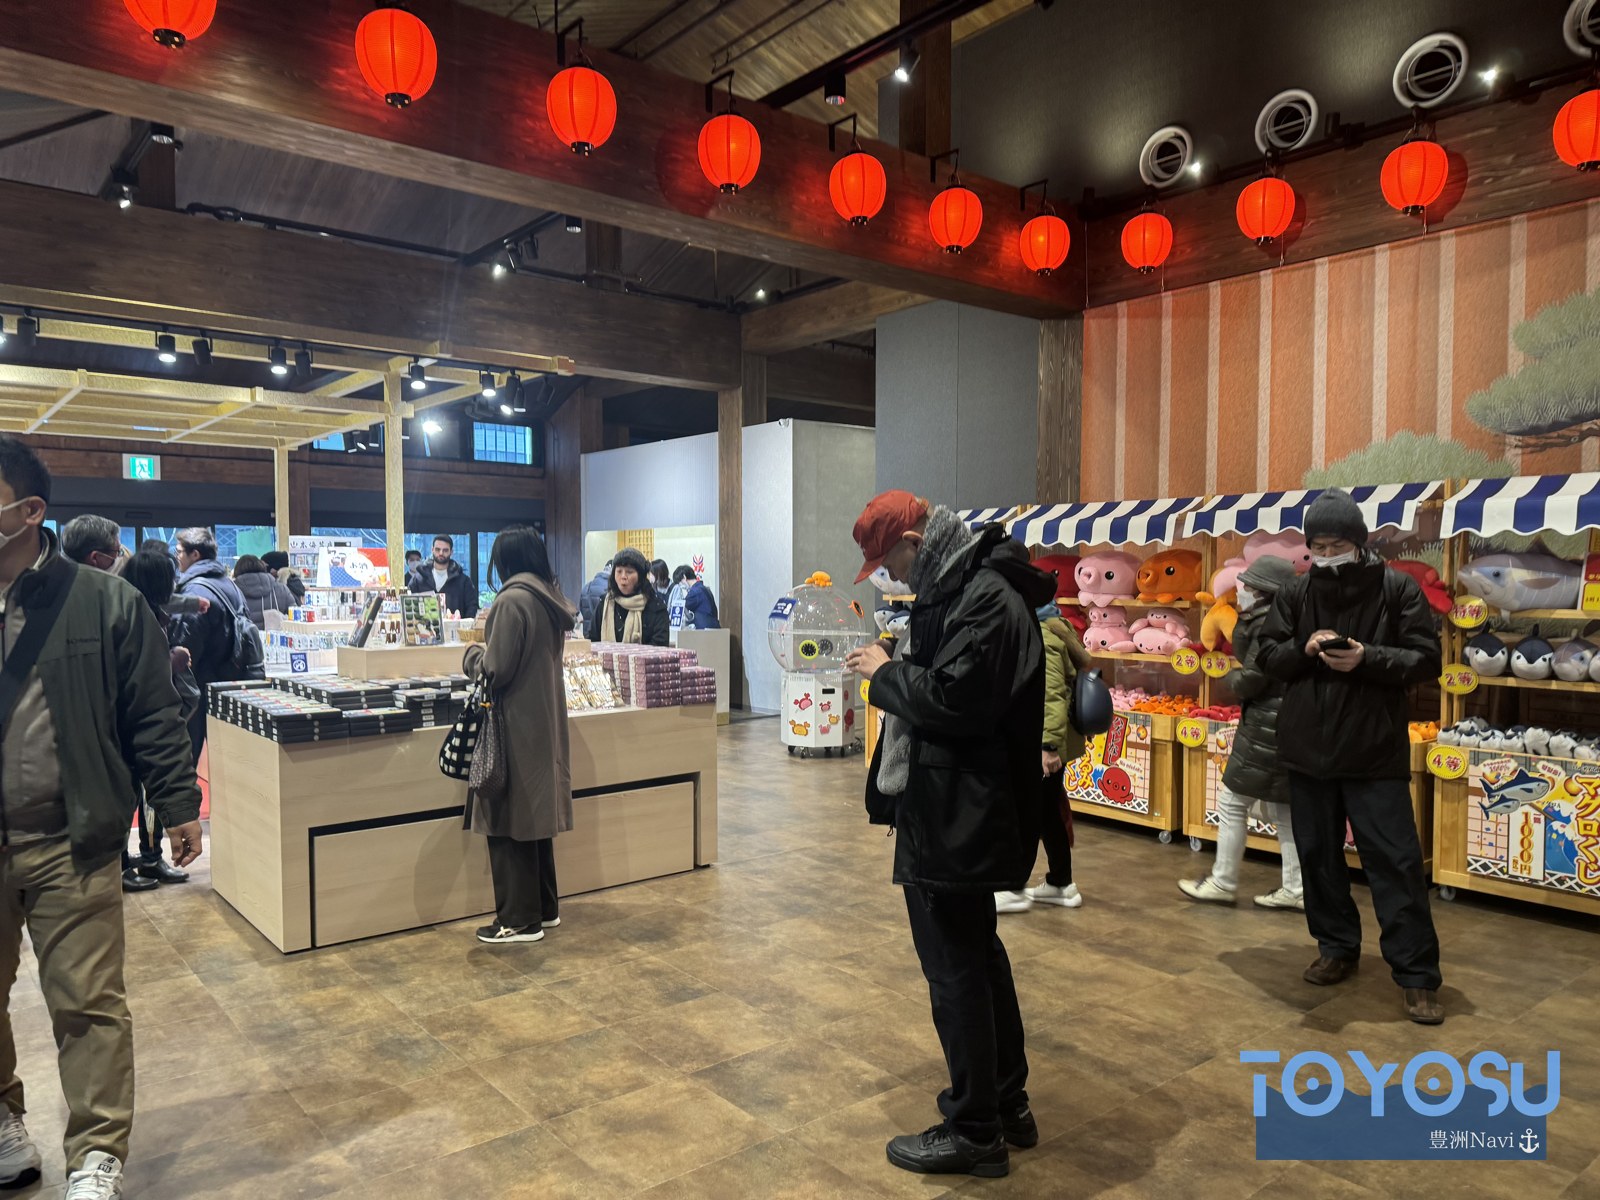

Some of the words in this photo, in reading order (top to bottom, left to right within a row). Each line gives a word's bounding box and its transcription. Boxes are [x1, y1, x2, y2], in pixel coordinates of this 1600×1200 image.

[1175, 654, 1197, 668] 2等
[1445, 671, 1475, 686] 2等
[1180, 726, 1202, 740] 4等
[1432, 754, 1462, 771] 4等
